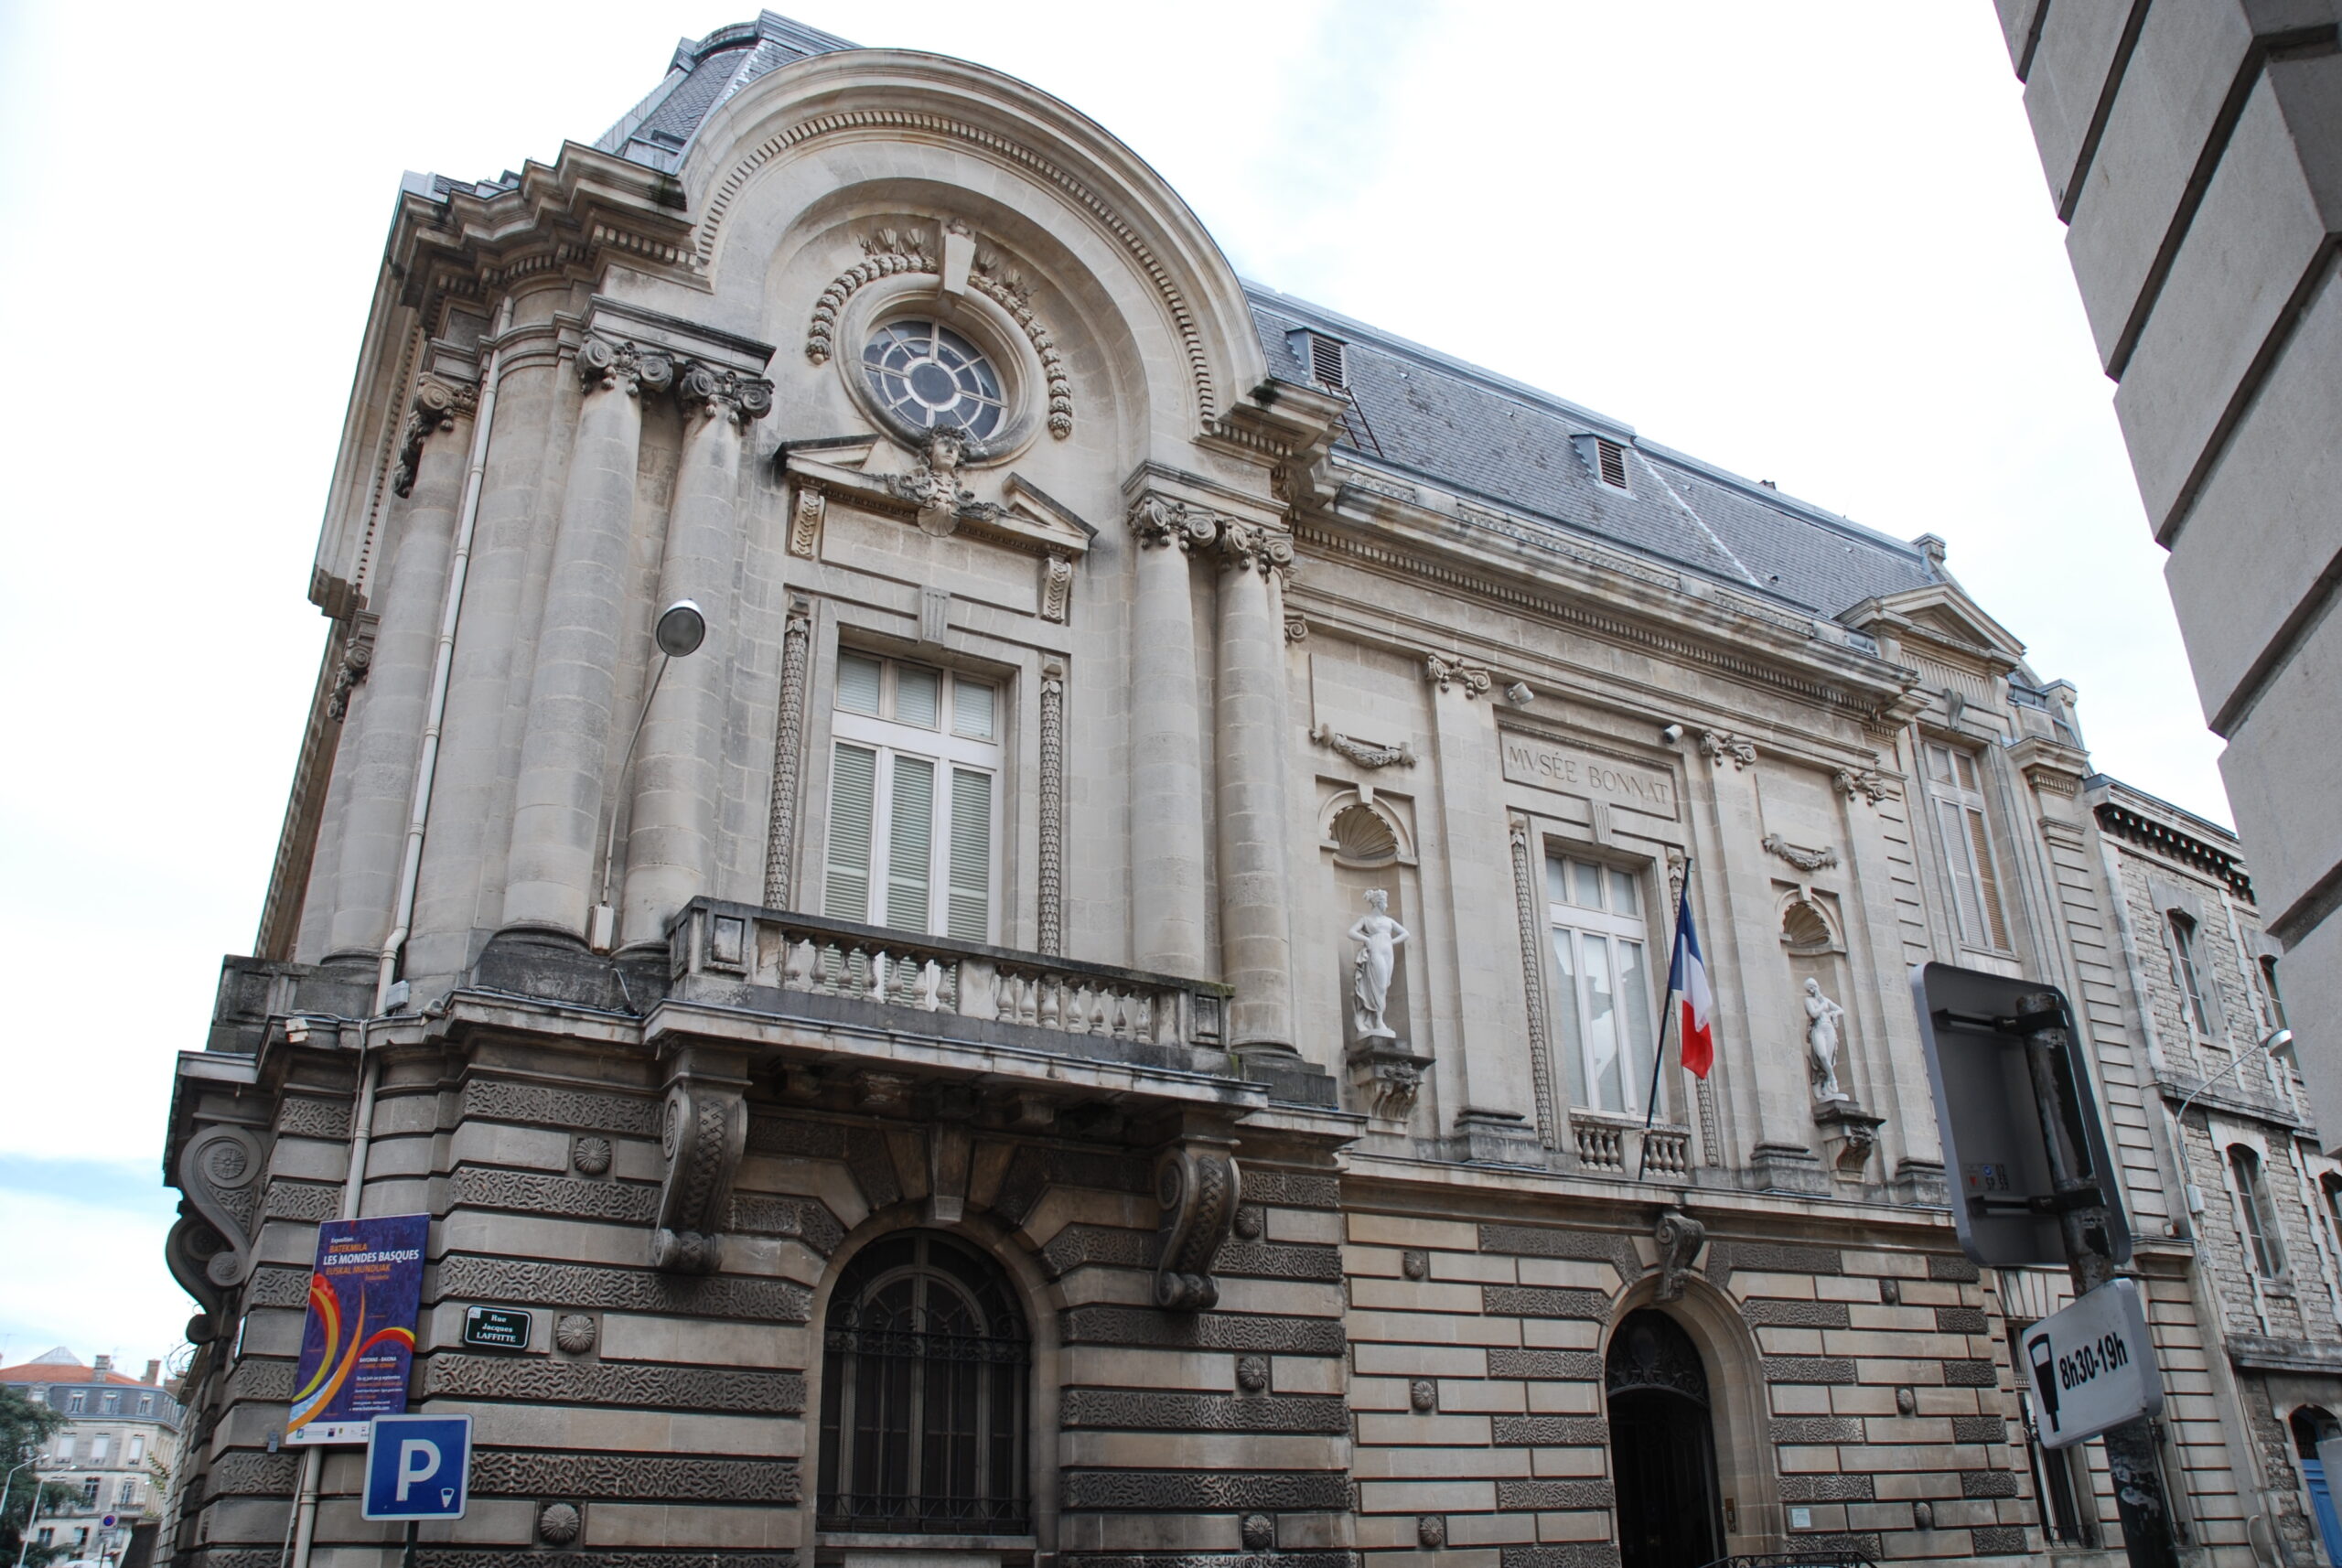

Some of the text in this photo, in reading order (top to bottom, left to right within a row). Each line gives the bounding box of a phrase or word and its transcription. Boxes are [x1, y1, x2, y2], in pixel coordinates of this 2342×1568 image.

[1588, 766, 1668, 805] BONNAT
[323, 1249, 420, 1265] LES MONDES BASQUES
[490, 1314, 507, 1323] Rue
[481, 1322, 513, 1333] Jacques
[476, 1331, 517, 1343] LAFFITTE
[2058, 1330, 2129, 1391] 8h30-19h
[395, 1438, 442, 1502] P
